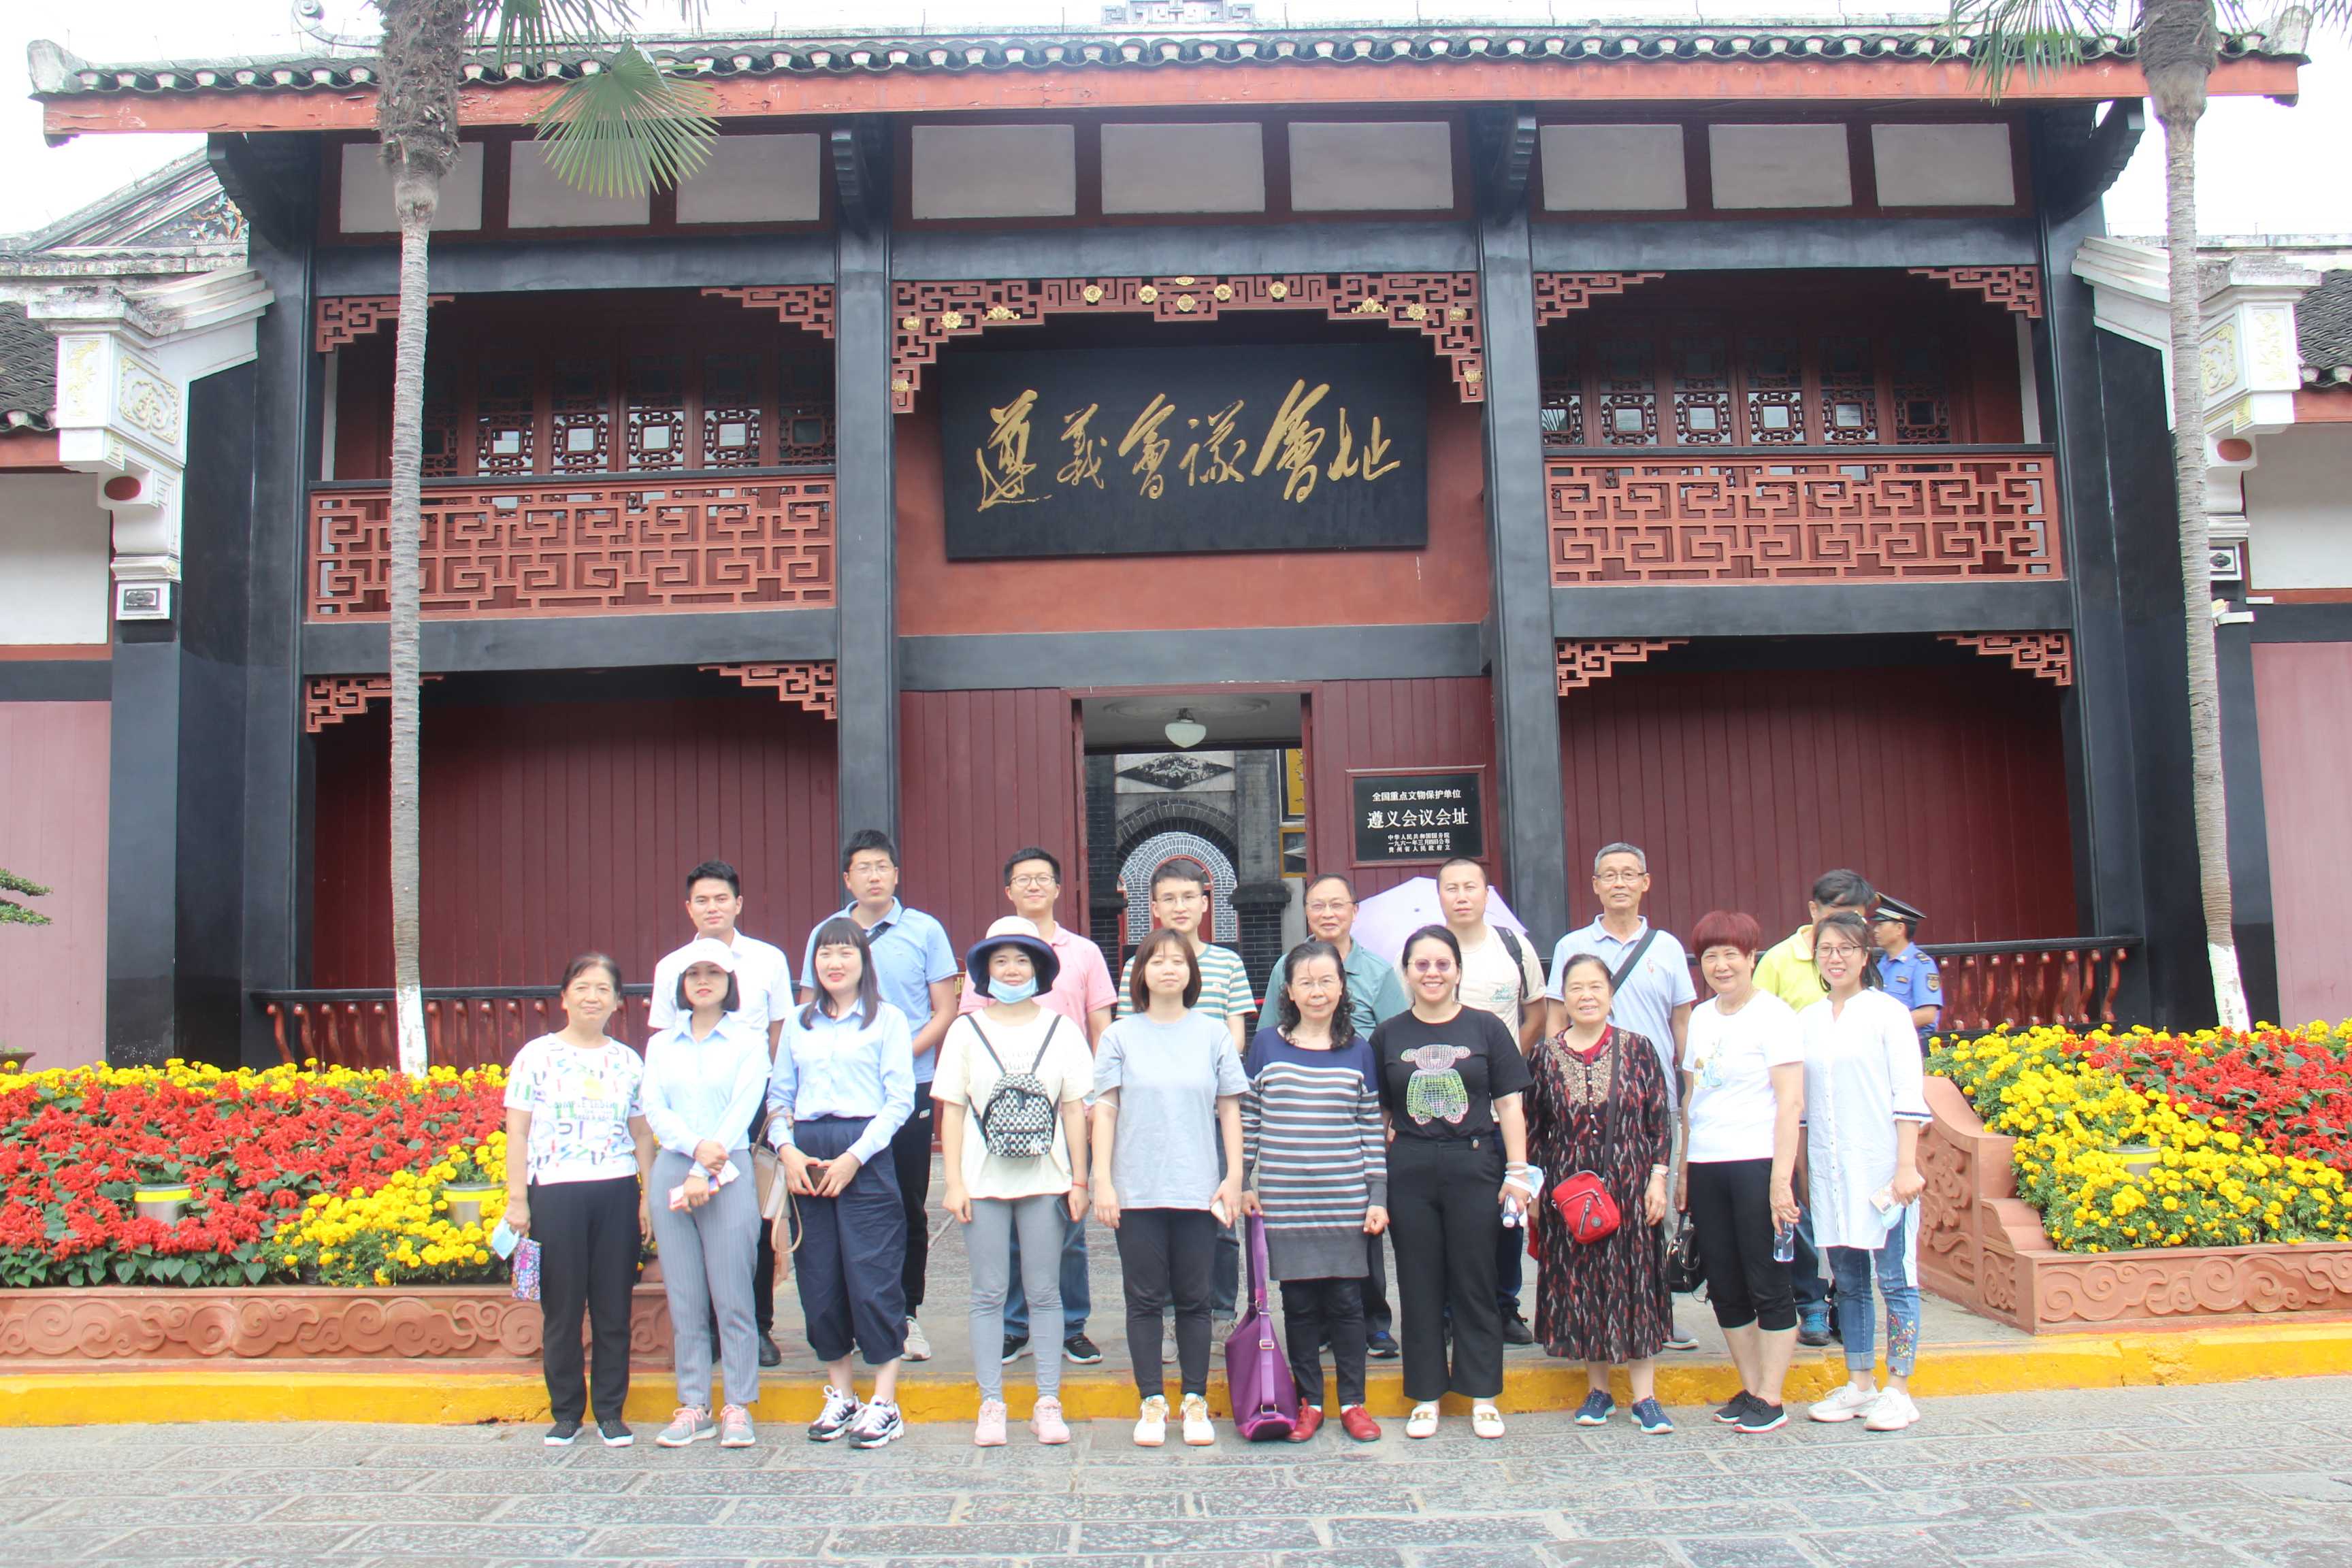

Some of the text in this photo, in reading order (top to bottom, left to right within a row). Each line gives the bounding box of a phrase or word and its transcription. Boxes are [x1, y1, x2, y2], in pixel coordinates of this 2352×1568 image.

[1372, 789, 1462, 802] 全国重点文物保护单位
[1367, 807, 1469, 829] 遵义会议会址
[1387, 832, 1450, 841] 中华人民共和国国务院
